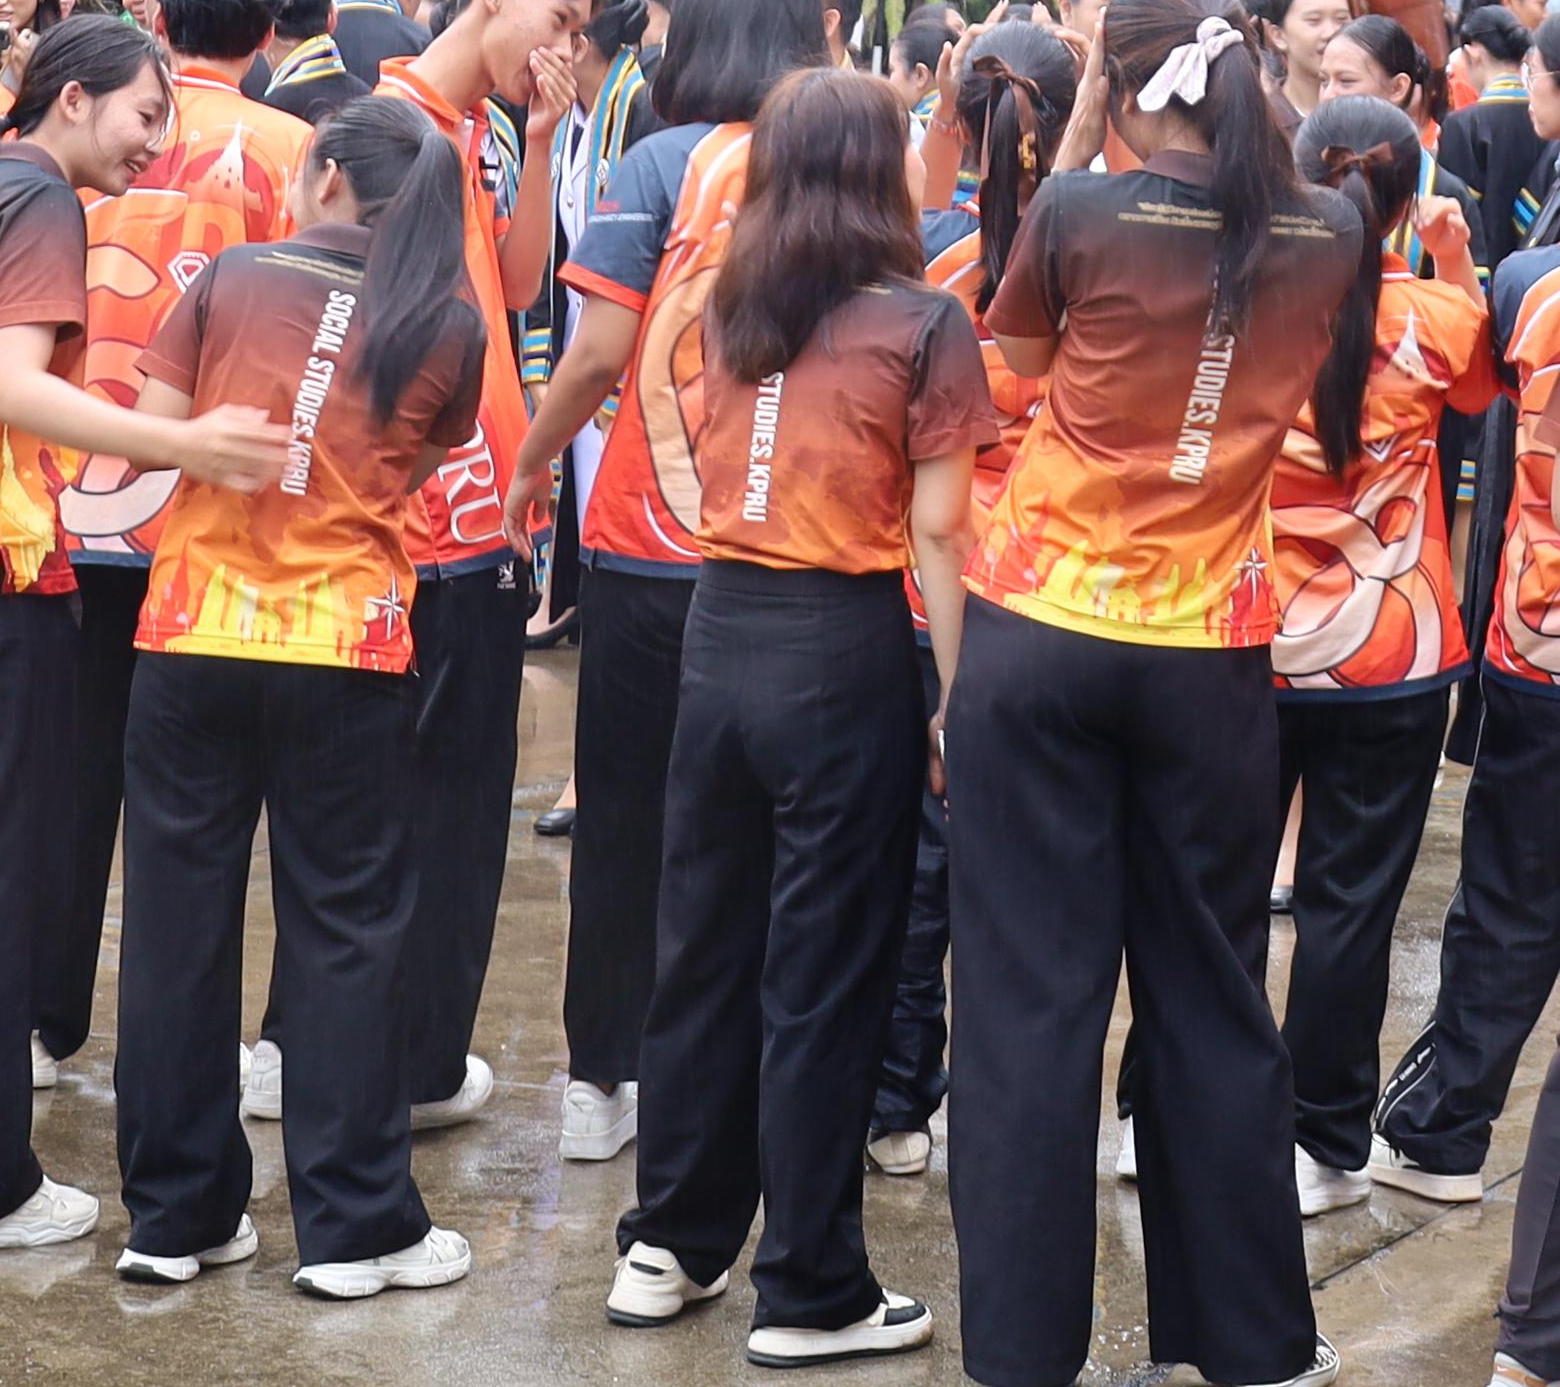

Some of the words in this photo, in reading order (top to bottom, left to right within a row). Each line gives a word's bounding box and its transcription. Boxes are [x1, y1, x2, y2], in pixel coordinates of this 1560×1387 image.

[312, 290, 356, 353] SOCIAL
[280, 355, 335, 496] STUDIES.KPRU
[742, 372, 785, 521] STUDIES.KPRU
[1169, 333, 1235, 485] STUDIES.KPRU
